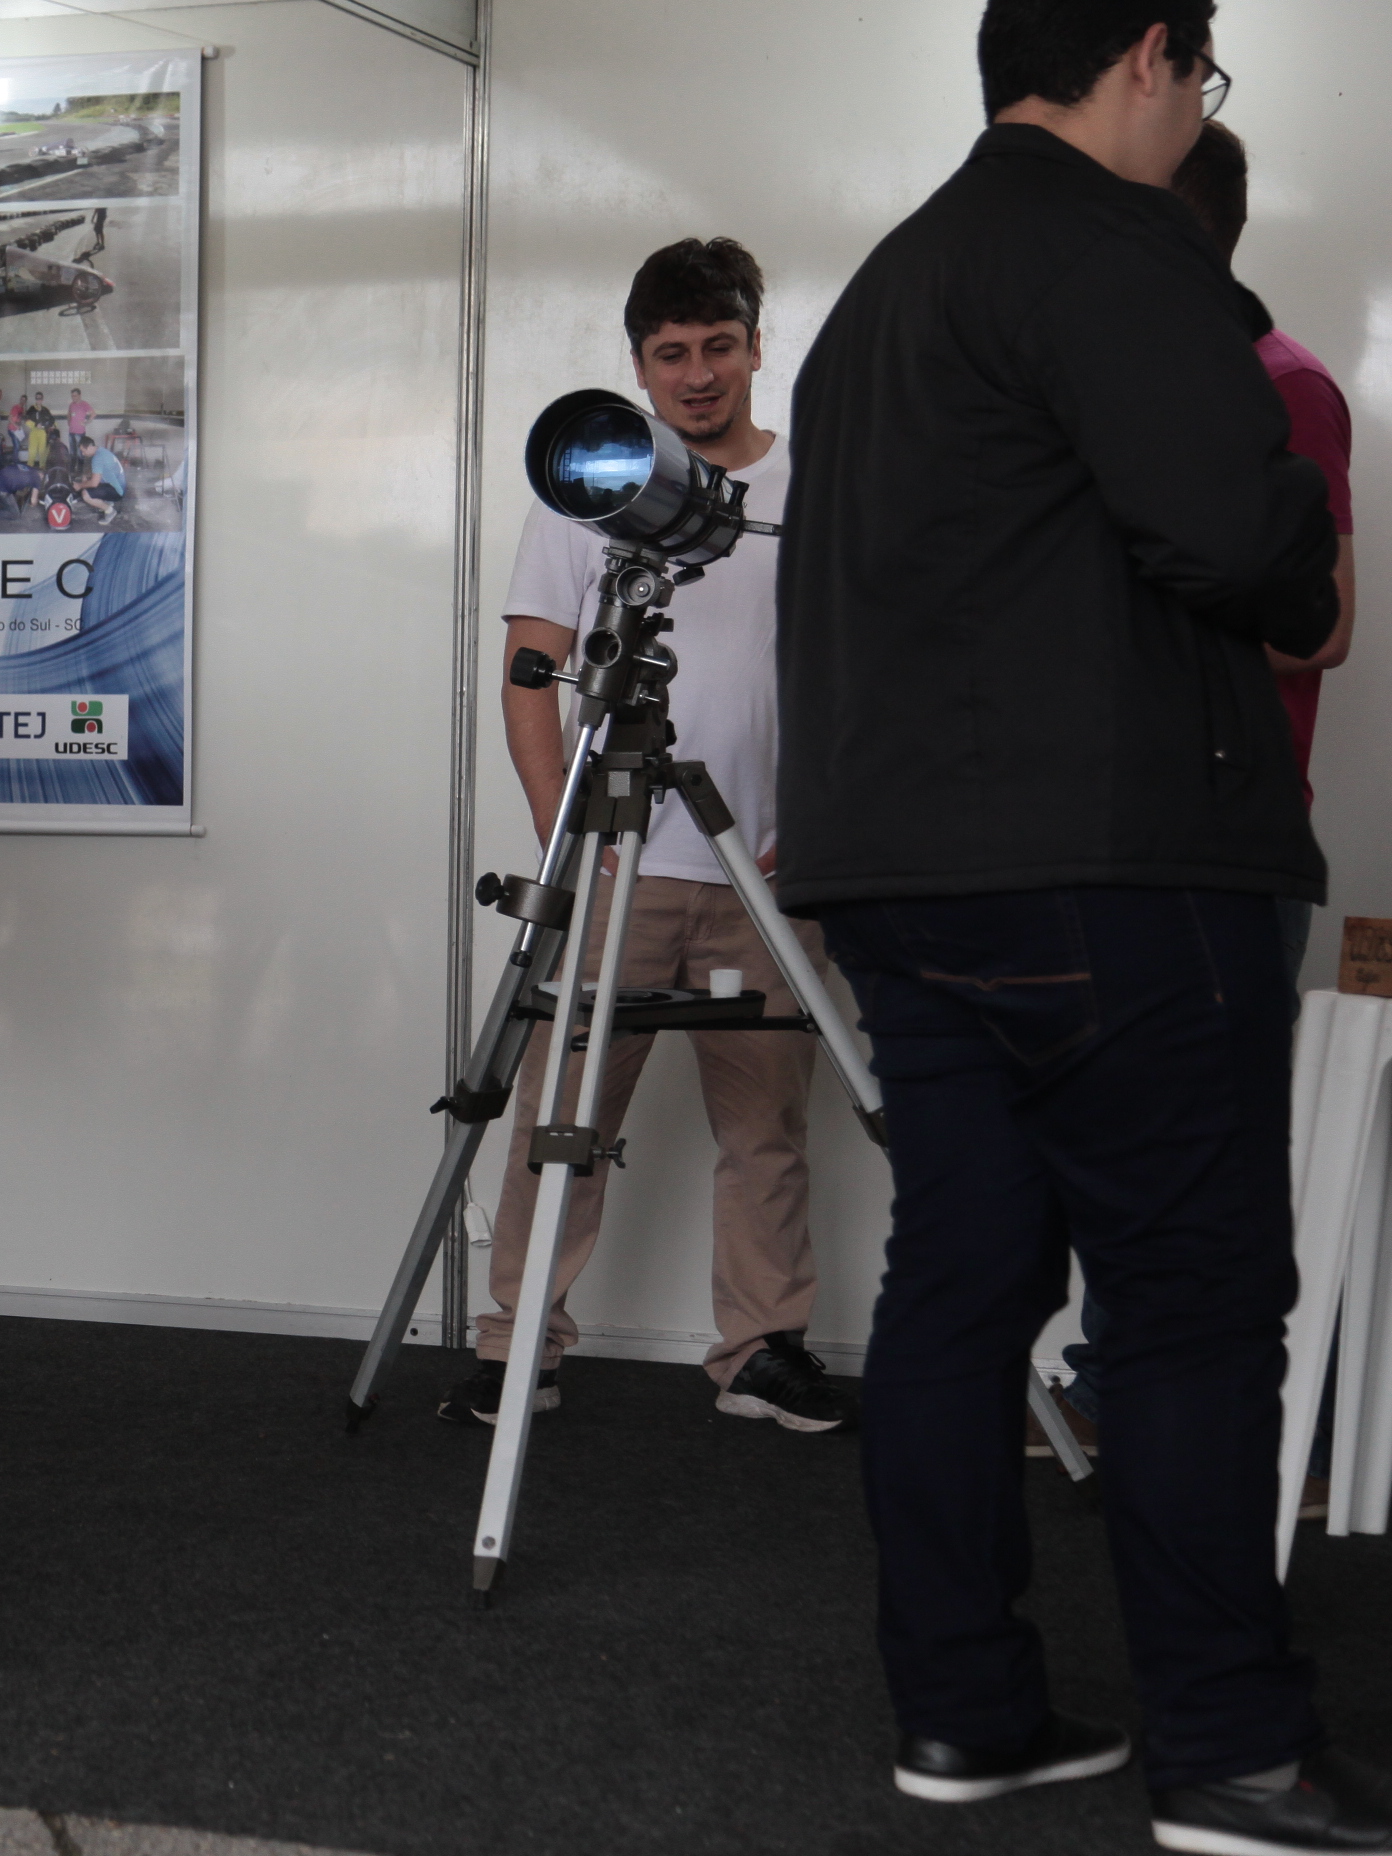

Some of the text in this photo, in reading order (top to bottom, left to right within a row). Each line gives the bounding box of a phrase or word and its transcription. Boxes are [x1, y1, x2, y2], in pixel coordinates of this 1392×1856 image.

[9, 618, 26, 631] do
[29, 617, 51, 632] Sul
[64, 617, 83, 632] SC
[54, 742, 118, 755] UDESC
